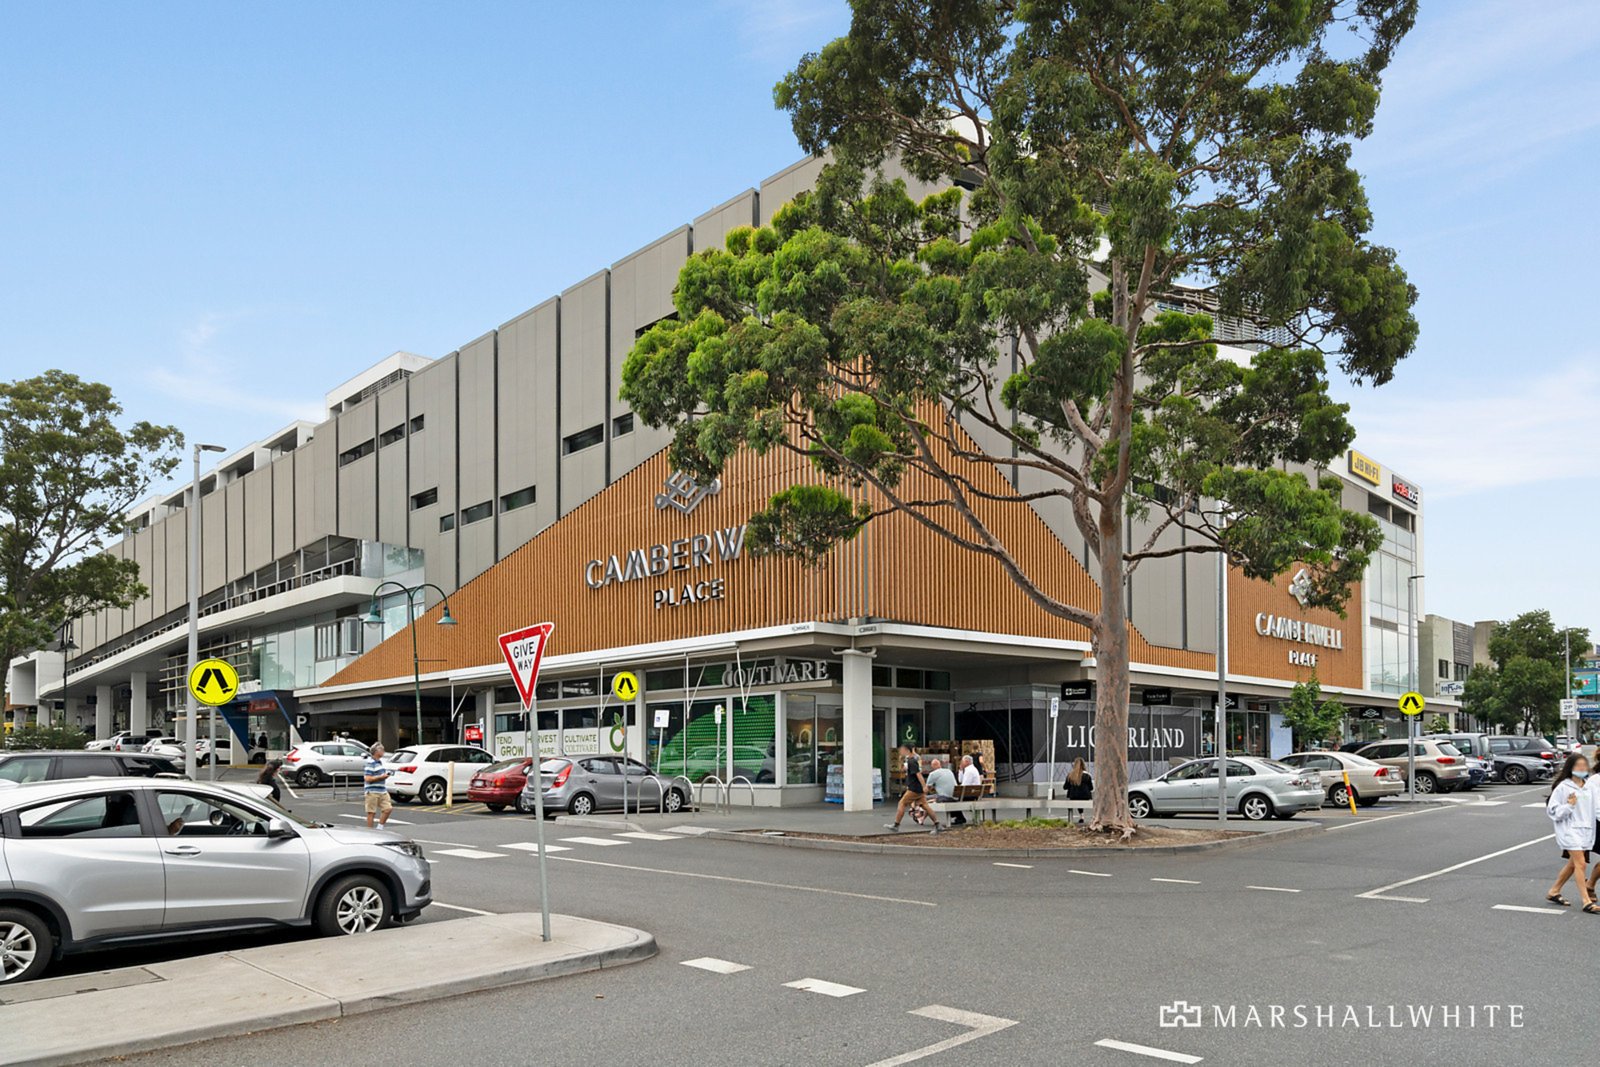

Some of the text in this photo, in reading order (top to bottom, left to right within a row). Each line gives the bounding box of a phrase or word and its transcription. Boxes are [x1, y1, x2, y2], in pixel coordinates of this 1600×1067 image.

[1354, 457, 1379, 480] JB HI-FI
[585, 524, 746, 589] CAMBERW
[654, 578, 724, 609] PLACE
[1255, 612, 1343, 650] CAMBERWELL
[513, 641, 535, 659] GIVE
[517, 658, 533, 671] WAY
[721, 660, 829, 688] COLTIVARE
[296, 715, 307, 729] P
[496, 736, 512, 745] TEND
[527, 734, 557, 744] HRVEST
[564, 734, 597, 743] CULTIVATE
[1066, 725, 1184, 748] LIRLAND
[500, 746, 524, 756] GROW
[564, 744, 598, 753] COLTIVARE
